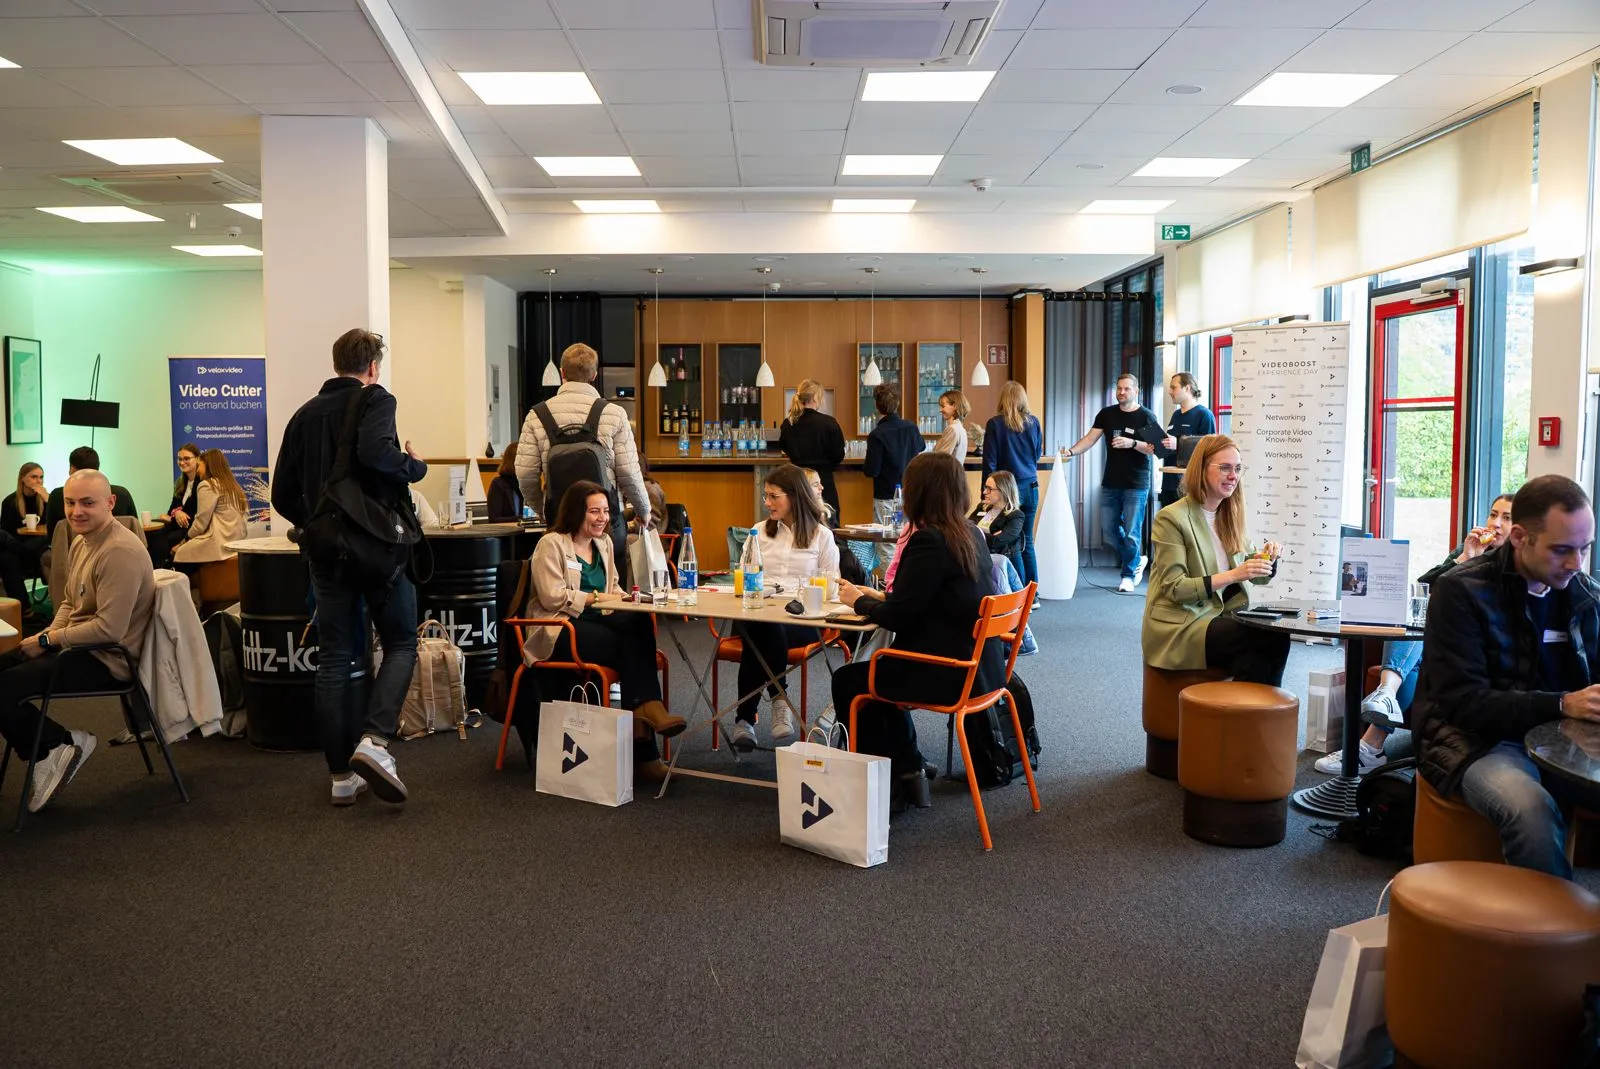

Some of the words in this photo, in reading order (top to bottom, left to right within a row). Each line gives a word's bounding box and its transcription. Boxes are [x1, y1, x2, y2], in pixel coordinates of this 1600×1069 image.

[179, 384, 218, 397] Video
[221, 384, 262, 397] Cutter
[180, 402, 190, 410] on
[194, 400, 228, 410] demand
[231, 400, 262, 409] buchen
[424, 608, 498, 646] fritz-k
